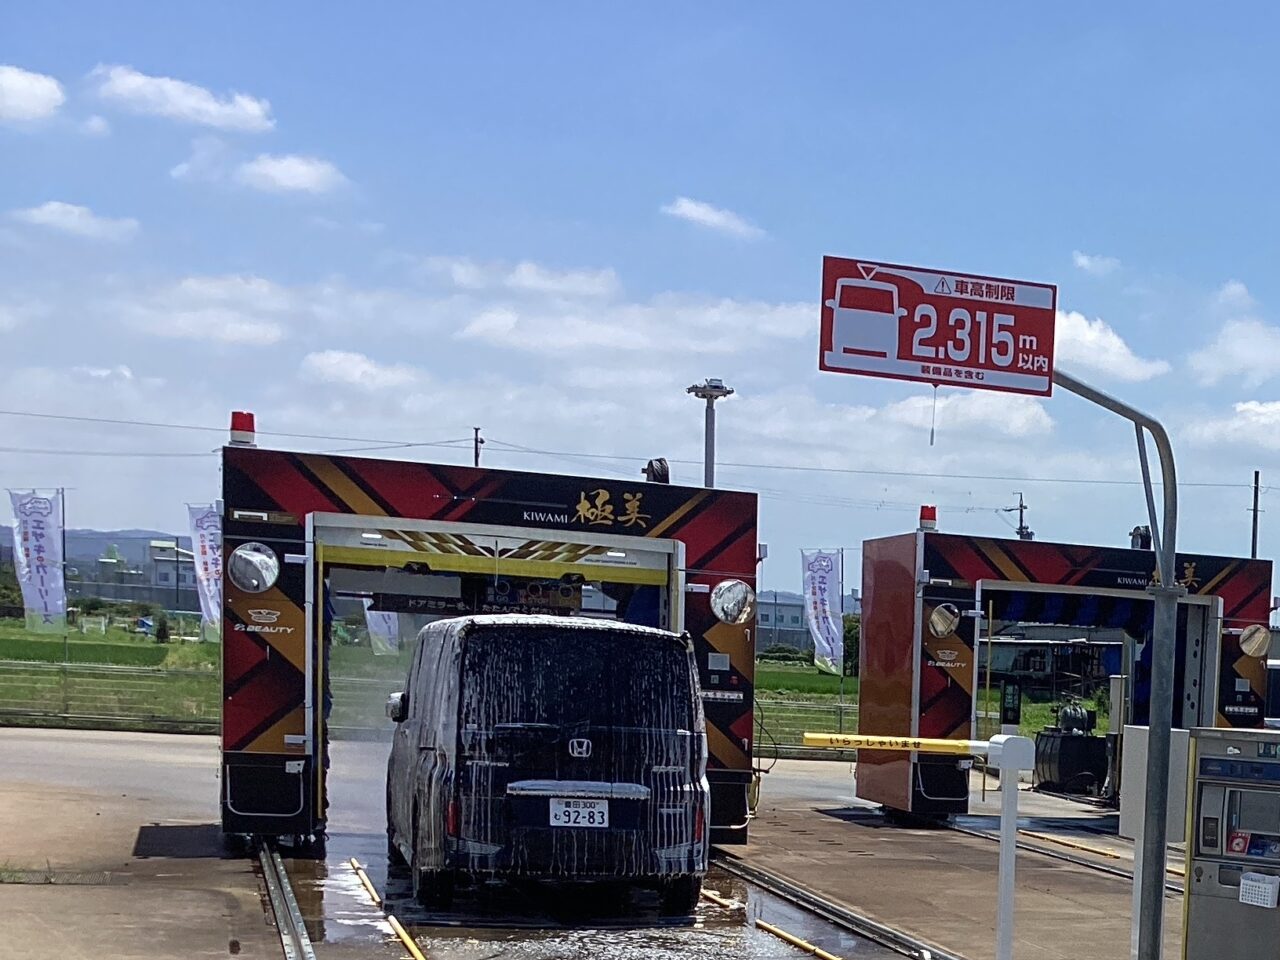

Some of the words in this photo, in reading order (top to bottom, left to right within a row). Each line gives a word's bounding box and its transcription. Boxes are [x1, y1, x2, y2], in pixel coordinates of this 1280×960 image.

[953, 280, 1016, 301] 車高制限
[912, 304, 1015, 367] 2.315
[1017, 352, 1049, 372] 以内
[921, 365, 985, 381] 装備品を含む
[523, 511, 568, 524] KIWAMI
[570, 488, 652, 529] 極美
[1117, 576, 1148, 586] KIWAMI
[246, 625, 295, 633] BEAUTY
[829, 737, 922, 749] いらっしゃいませ
[563, 810, 605, 825] 92-83
